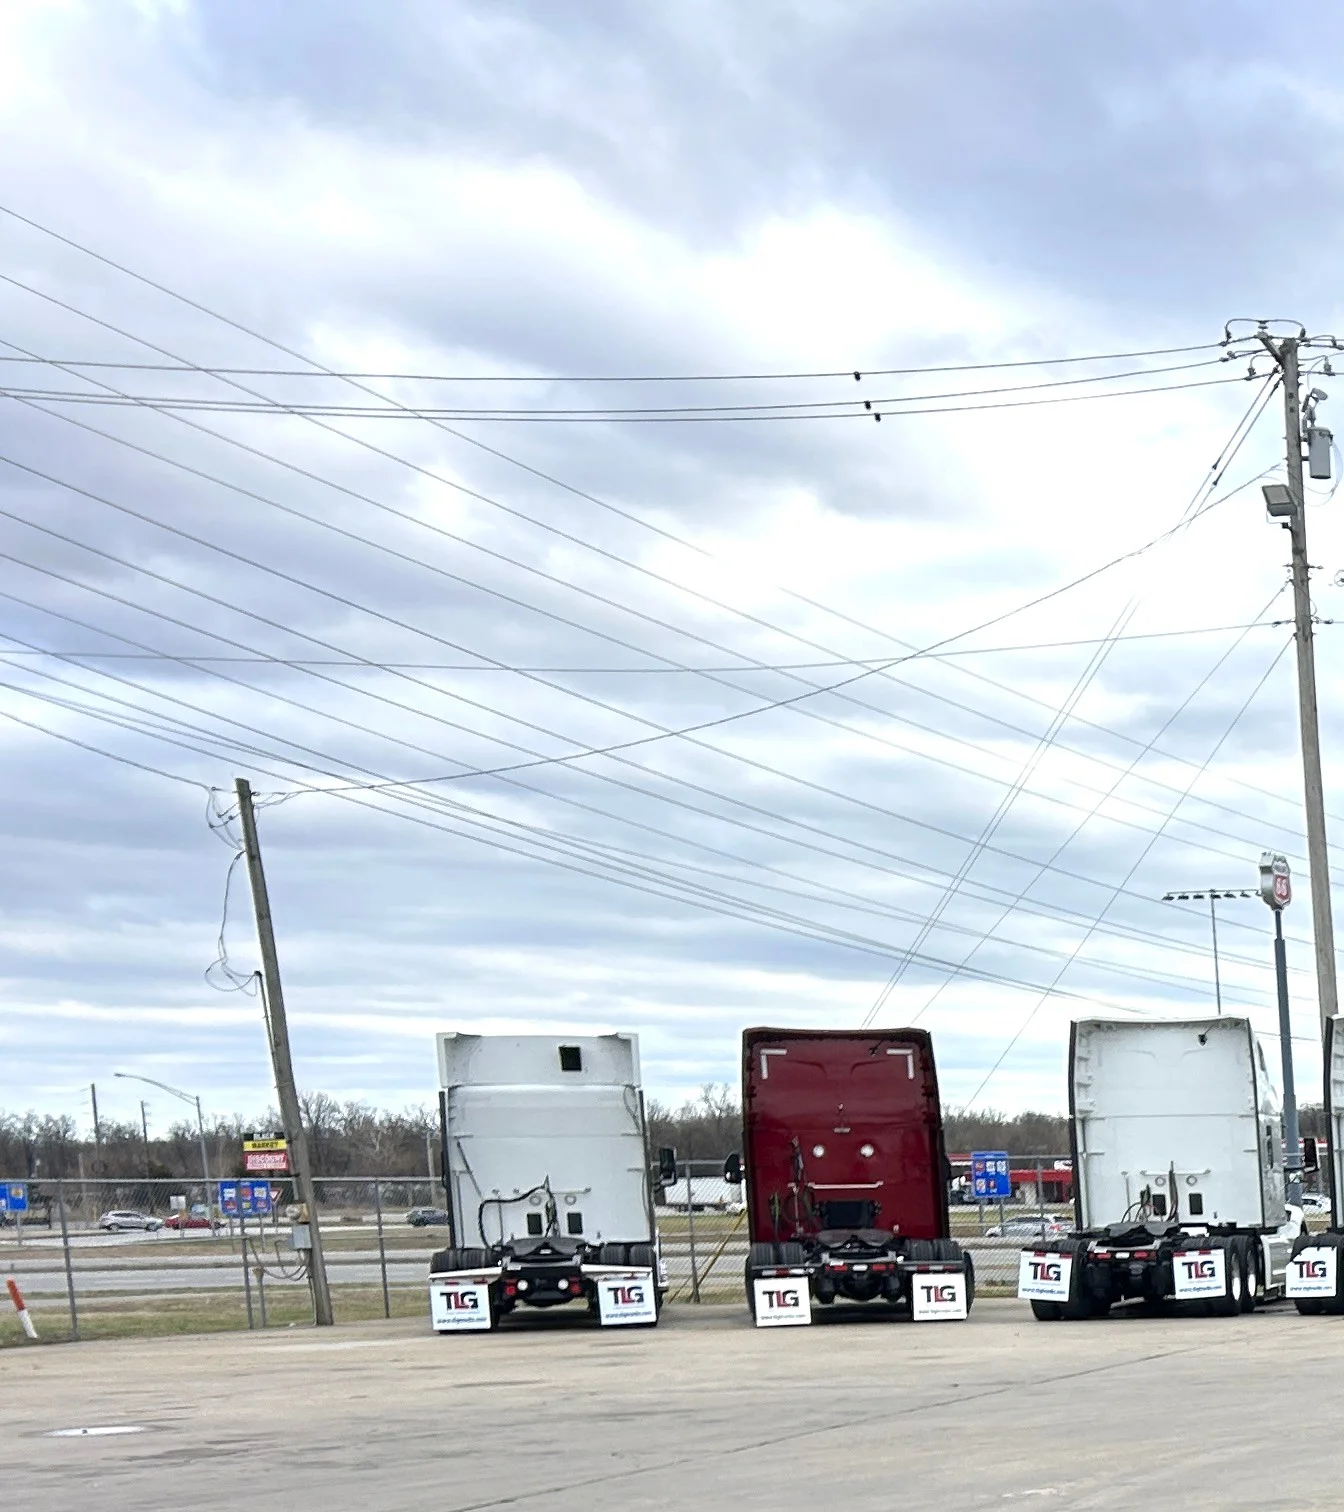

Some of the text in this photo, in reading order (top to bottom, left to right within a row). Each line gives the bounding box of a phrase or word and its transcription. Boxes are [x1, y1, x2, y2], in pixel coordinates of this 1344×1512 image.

[1028, 1261, 1061, 1282] TLG
[1181, 1260, 1216, 1279] TLG
[1293, 1260, 1327, 1279] TLG
[440, 1291, 478, 1310] TLG
[607, 1286, 644, 1304] TLG
[762, 1289, 799, 1308] TLG
[920, 1285, 956, 1303] TLG
